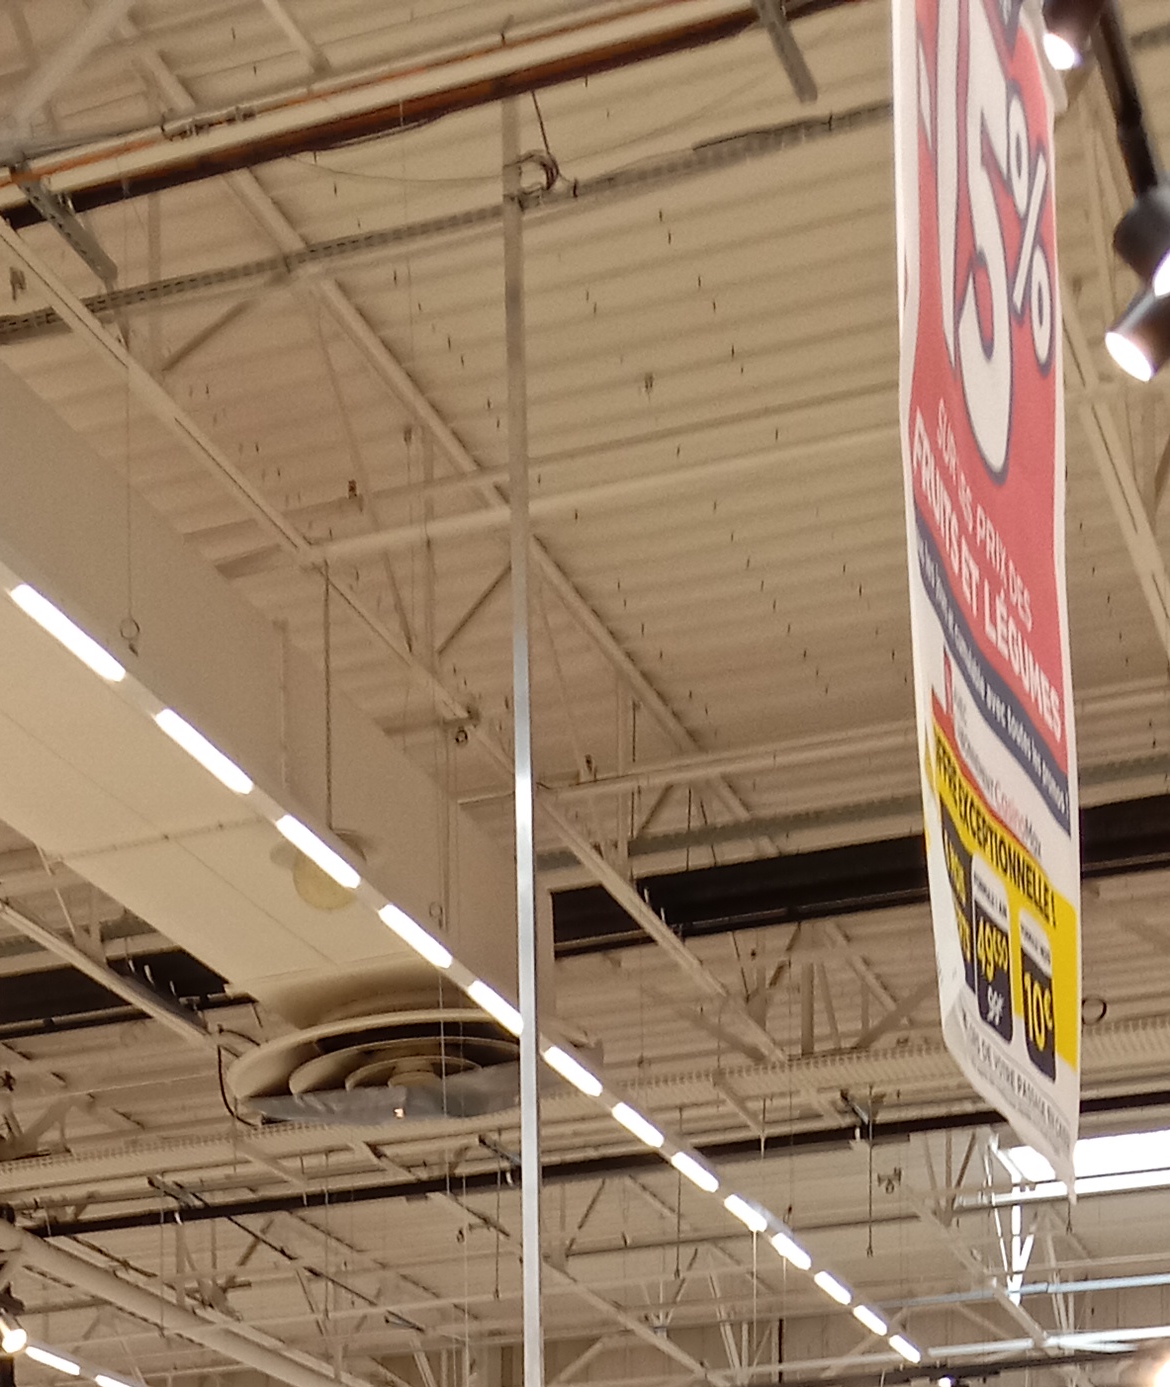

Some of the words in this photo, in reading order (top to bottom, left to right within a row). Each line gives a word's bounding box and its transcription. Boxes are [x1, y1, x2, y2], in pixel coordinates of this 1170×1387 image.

[913, 405, 960, 576] FRUITS
[961, 535, 981, 618] ET
[985, 577, 1062, 742] LÉGUMES
[977, 504, 1008, 590] PRIX
[1009, 559, 1032, 633] DES
